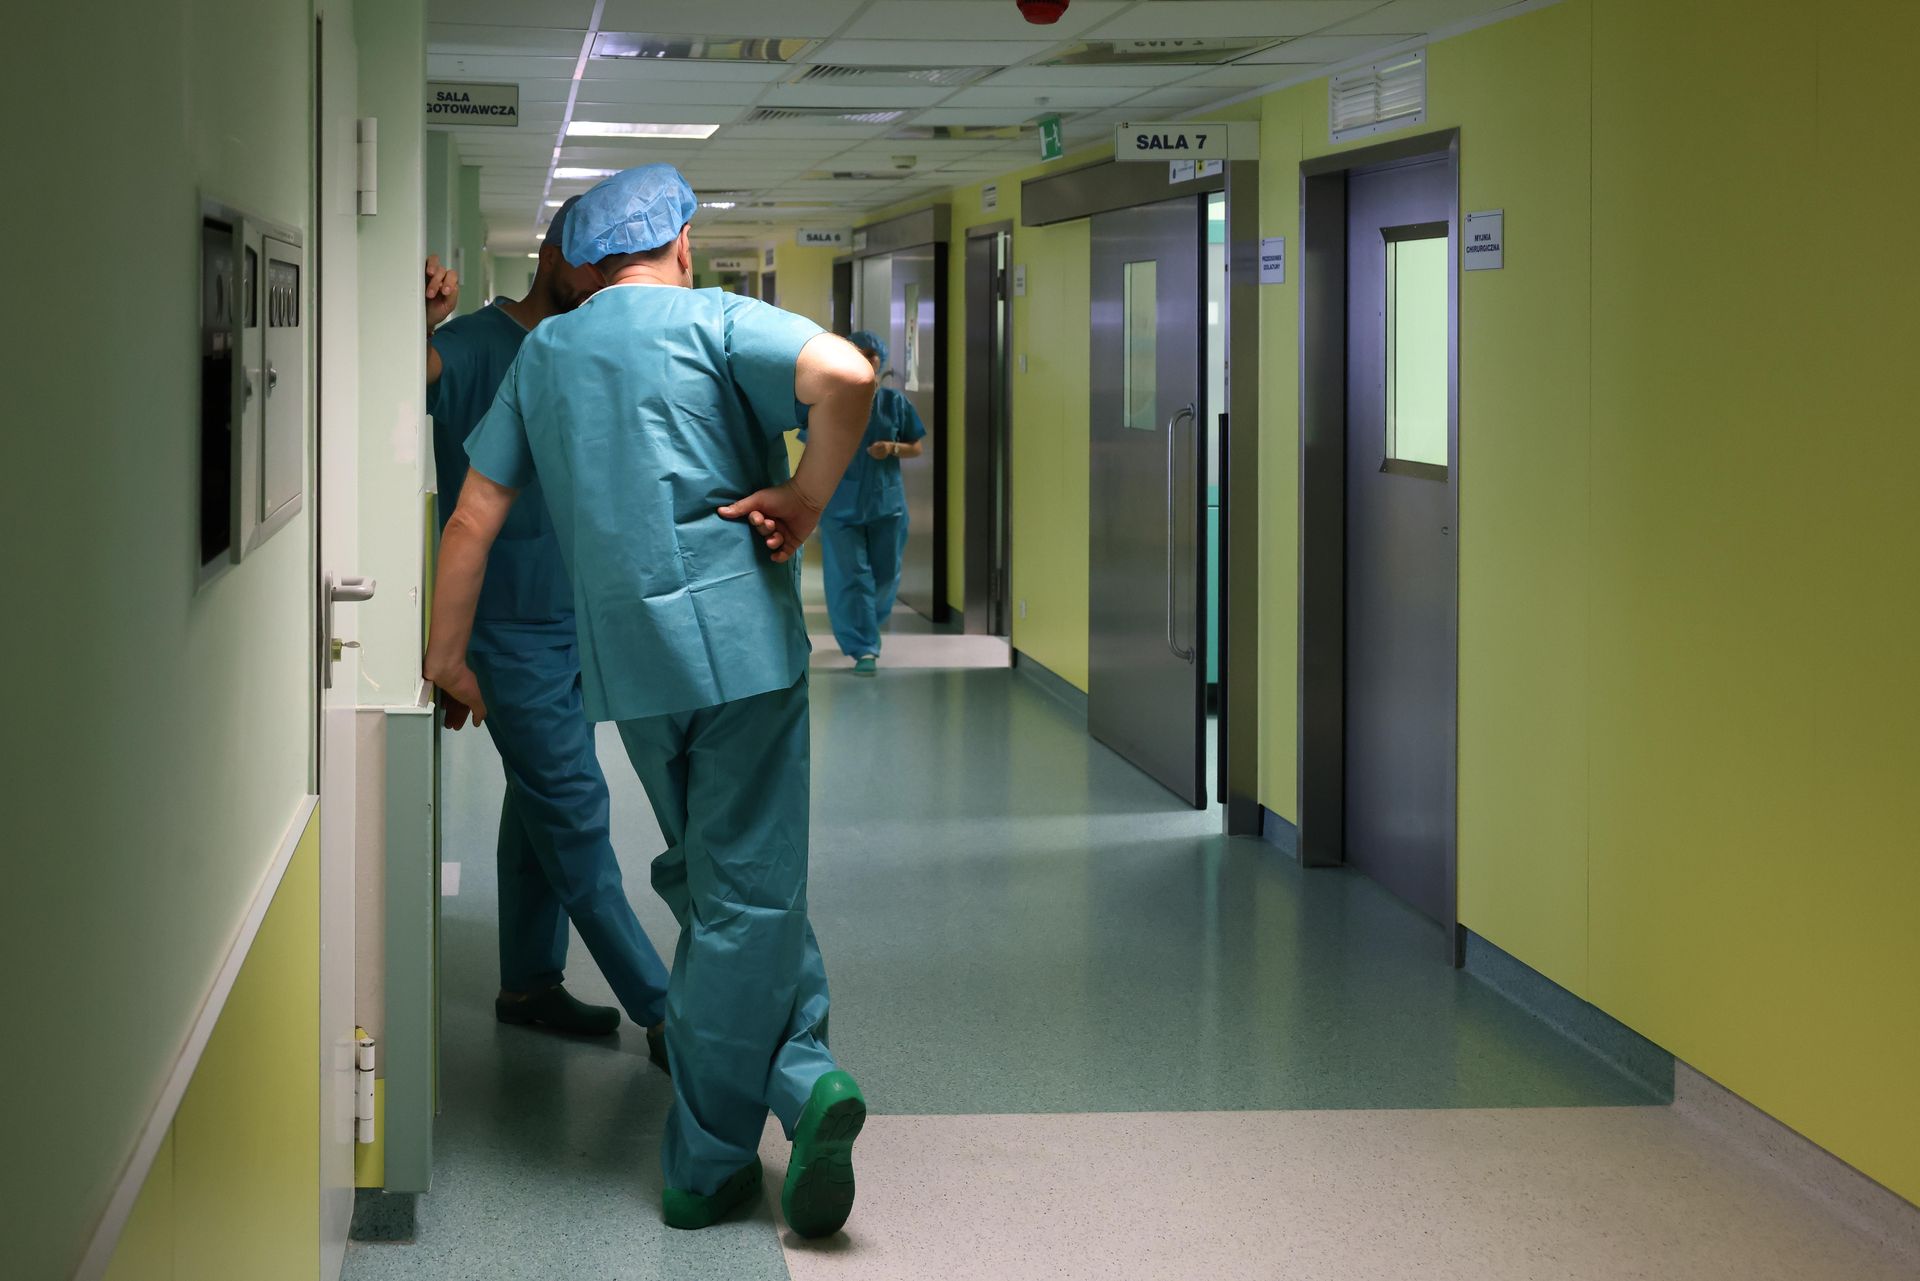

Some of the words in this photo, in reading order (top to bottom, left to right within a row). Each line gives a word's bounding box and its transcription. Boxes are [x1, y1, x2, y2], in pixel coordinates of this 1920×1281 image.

[436, 91, 470, 102] SALA
[1136, 134, 1189, 150] SALA
[1195, 134, 1207, 149] 7
[806, 233, 832, 242] SALA
[834, 233, 841, 241] 6
